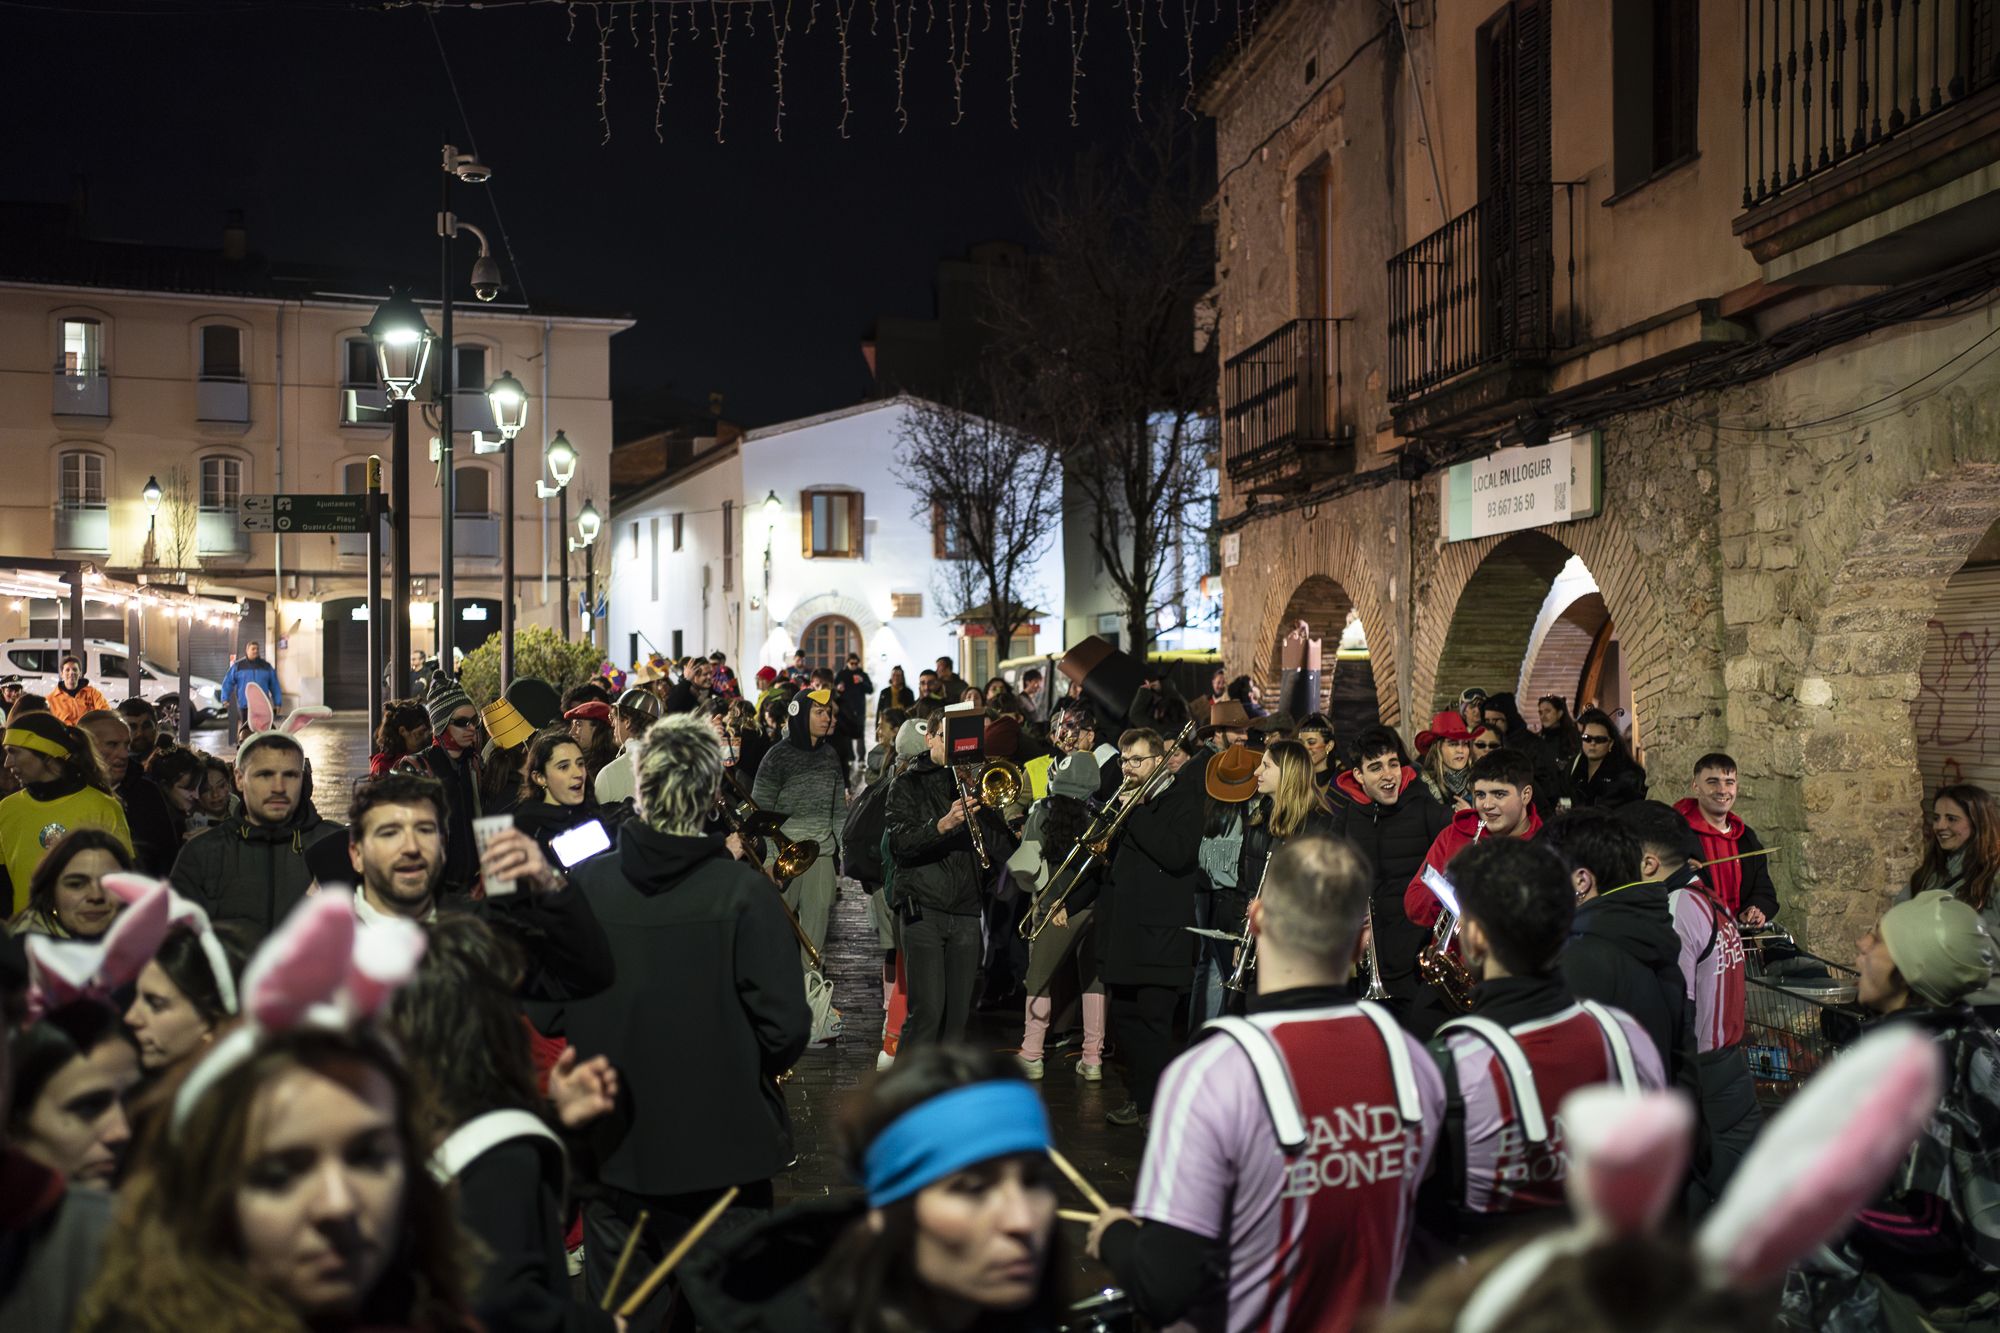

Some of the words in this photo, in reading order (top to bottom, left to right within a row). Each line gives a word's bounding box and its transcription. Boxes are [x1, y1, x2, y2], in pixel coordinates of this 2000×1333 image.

[1473, 472, 1498, 493] LOCAL
[1500, 469, 1511, 486] EN
[1512, 458, 1552, 482] LLOGUER
[1487, 502, 1497, 518] 93
[1498, 498, 1512, 516] 667
[1513, 495, 1524, 513] 36
